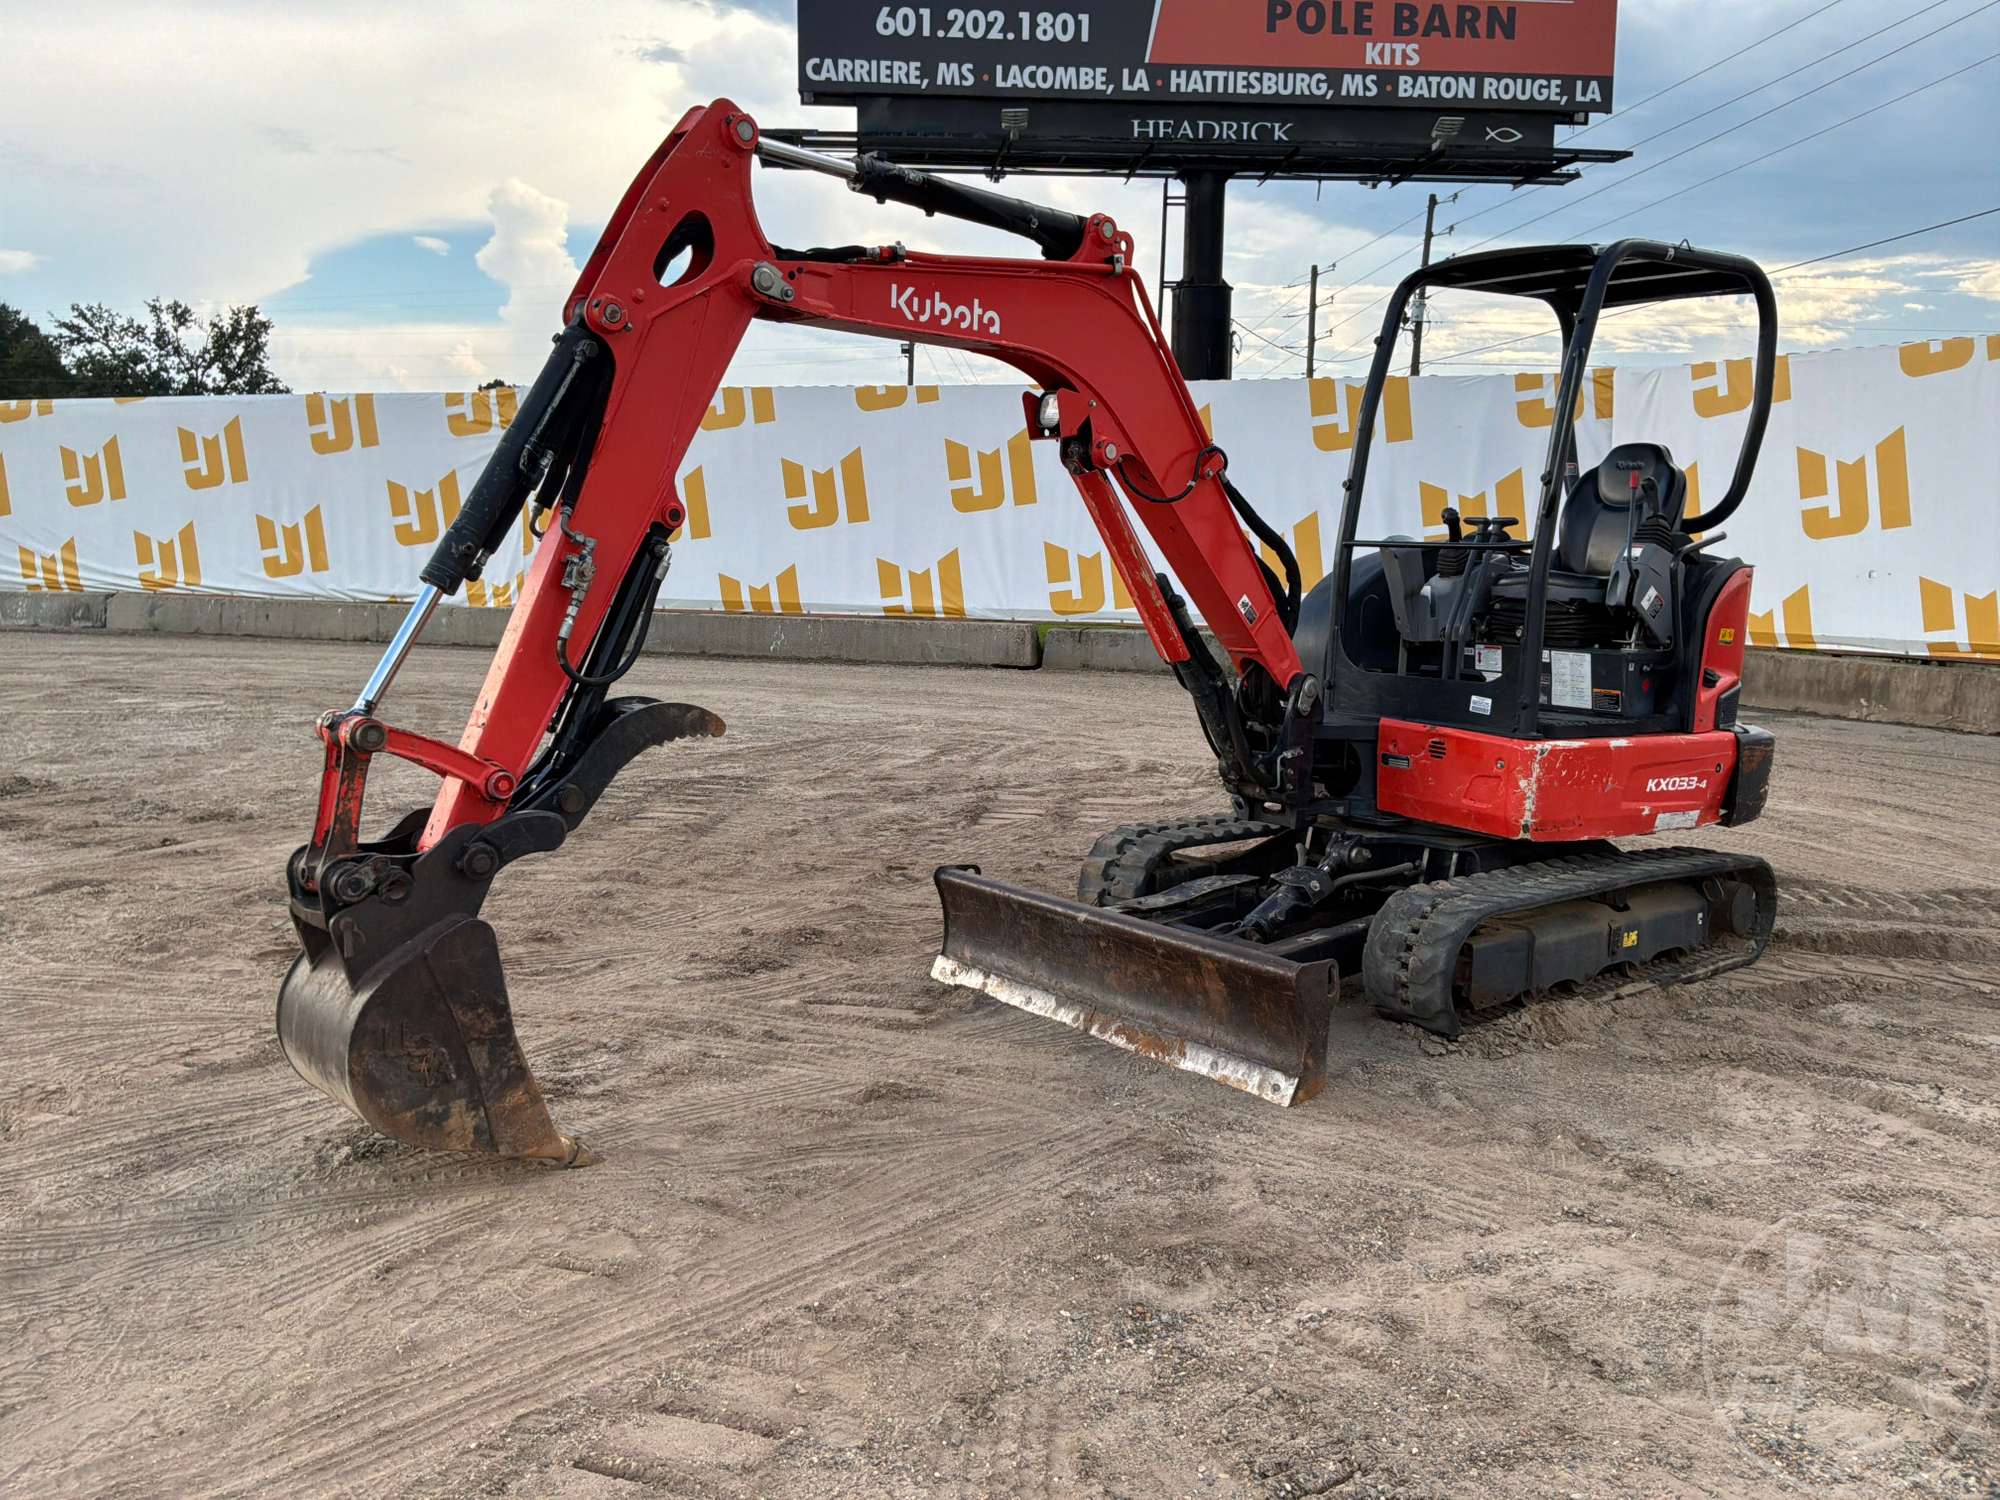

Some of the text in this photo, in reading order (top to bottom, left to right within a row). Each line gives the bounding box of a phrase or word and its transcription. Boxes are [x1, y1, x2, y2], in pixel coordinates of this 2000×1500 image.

[875, 6, 1091, 43] 601.202.1801
[1266, 0, 1516, 40] POLE BARN
[1364, 41, 1420, 66] KITS
[805, 57, 1602, 105] CARRIERE, MS LACOMBE, LA HATTIESBURG, MS BATON ROUGE, LA
[1131, 119, 1293, 141] HEADRICK
[890, 283, 1001, 335] Kubota
[1646, 776, 1708, 792] KX033-4
